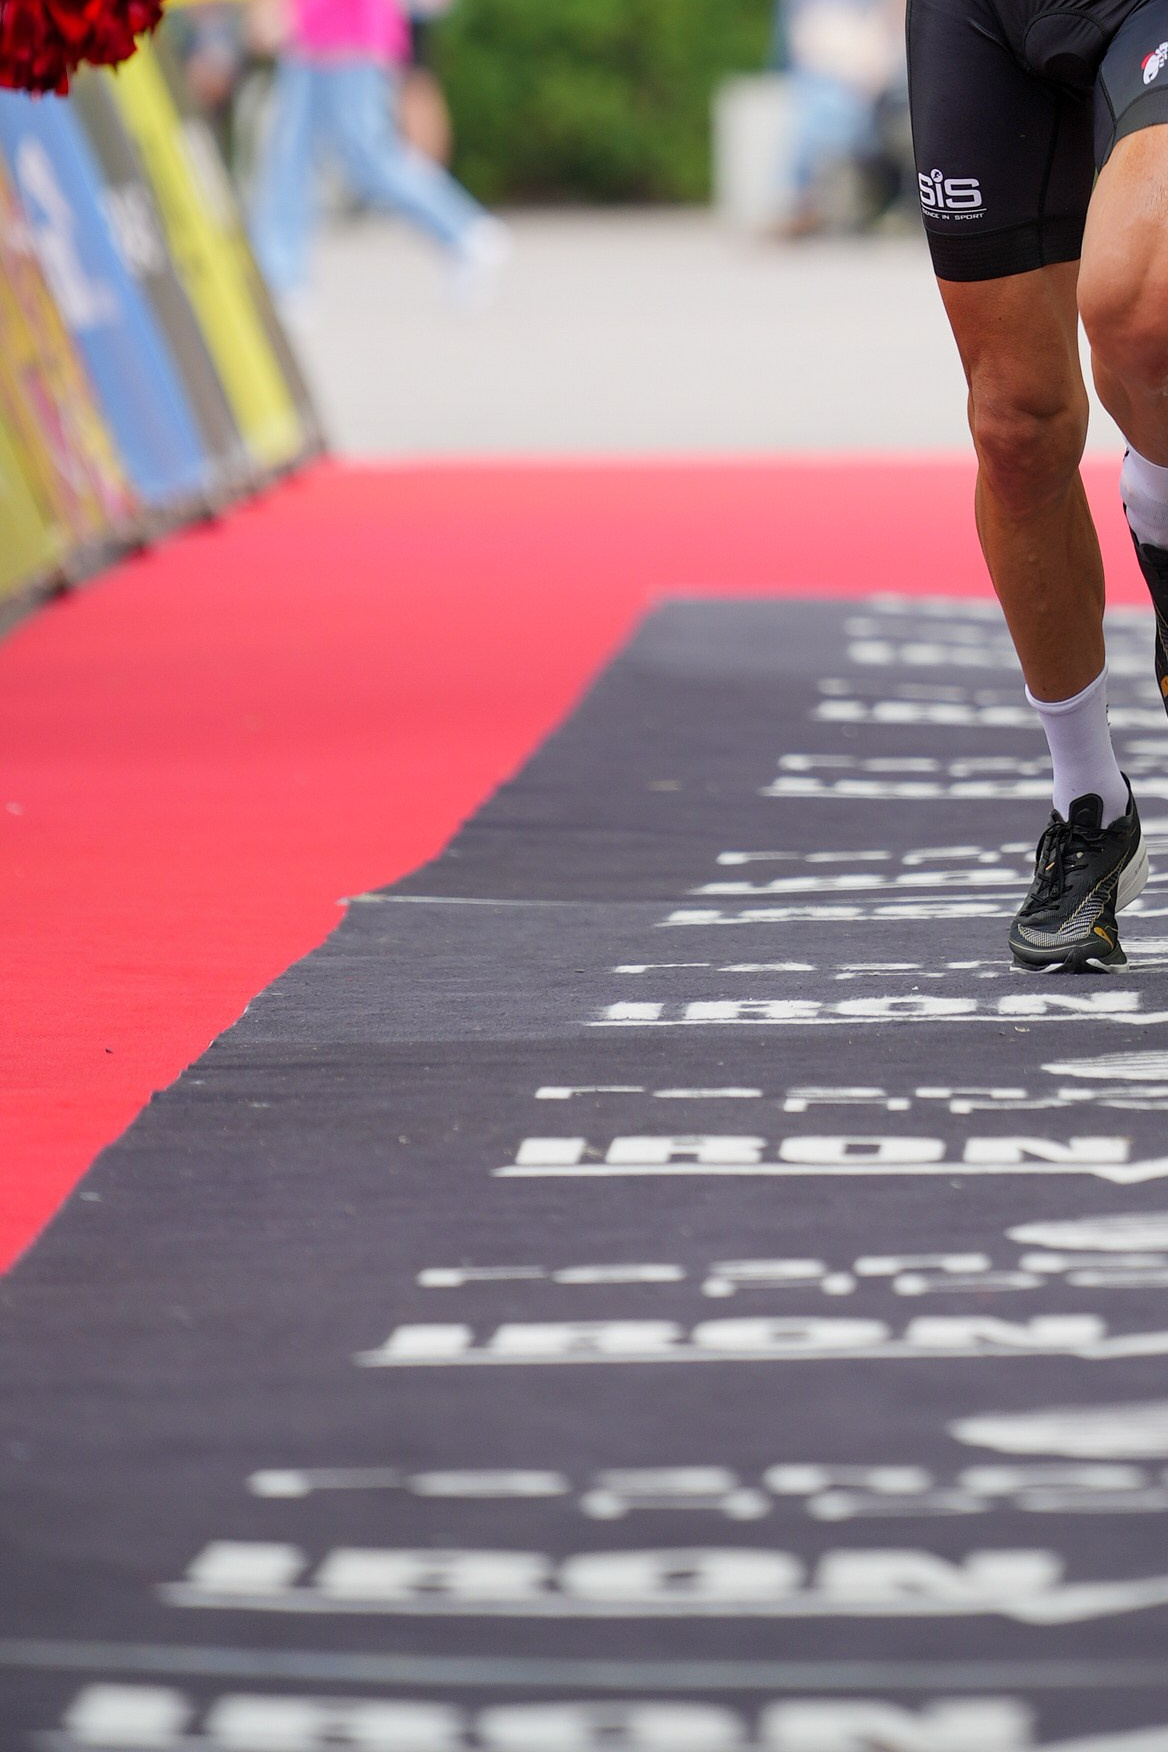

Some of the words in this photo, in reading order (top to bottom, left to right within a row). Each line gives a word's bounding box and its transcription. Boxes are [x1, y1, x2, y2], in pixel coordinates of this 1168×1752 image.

[954, 213, 984, 221] SPORT
[604, 990, 1141, 1021] IRON
[514, 1135, 1131, 1165] IRON
[386, 1314, 1107, 1357] IRON
[185, 1540, 1065, 1600] IRON
